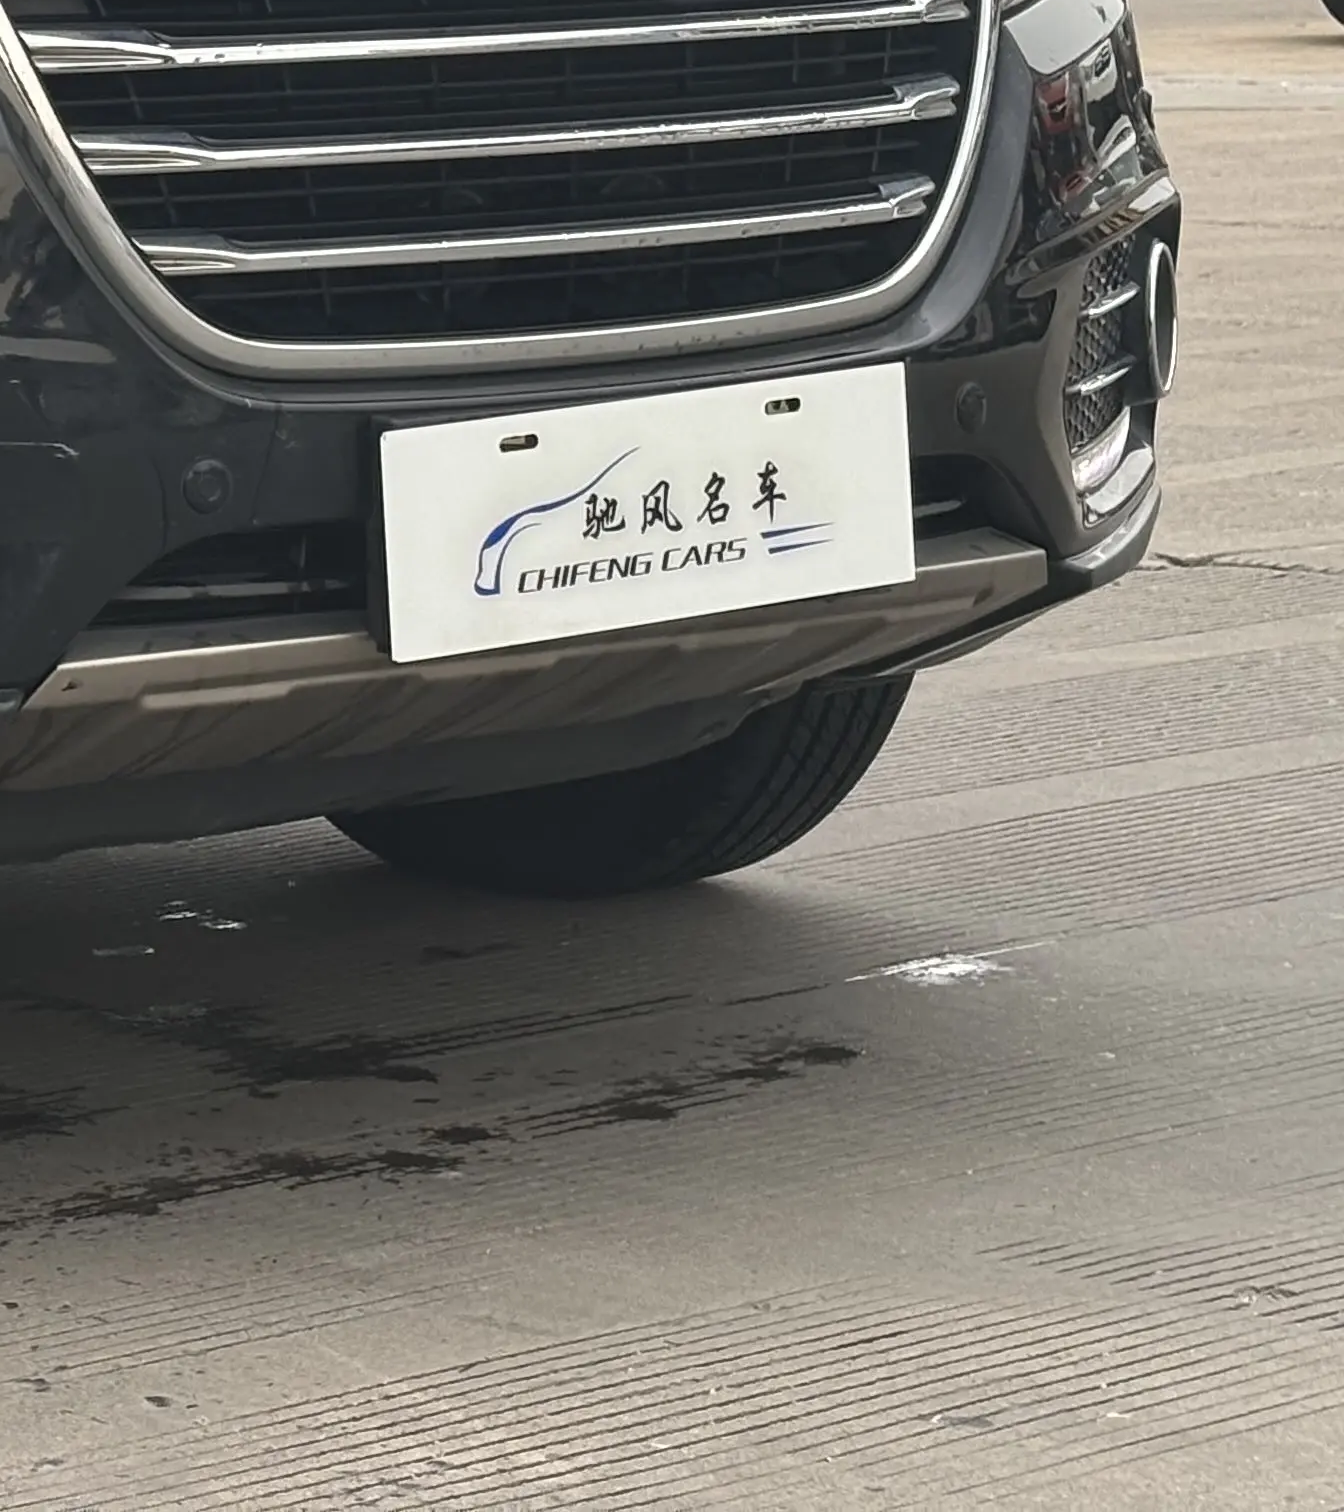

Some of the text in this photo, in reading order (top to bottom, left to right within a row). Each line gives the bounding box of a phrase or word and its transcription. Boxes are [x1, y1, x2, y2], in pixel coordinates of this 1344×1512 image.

[582, 460, 787, 540] 驰风名车
[517, 537, 748, 594] CHIFENG CARS
